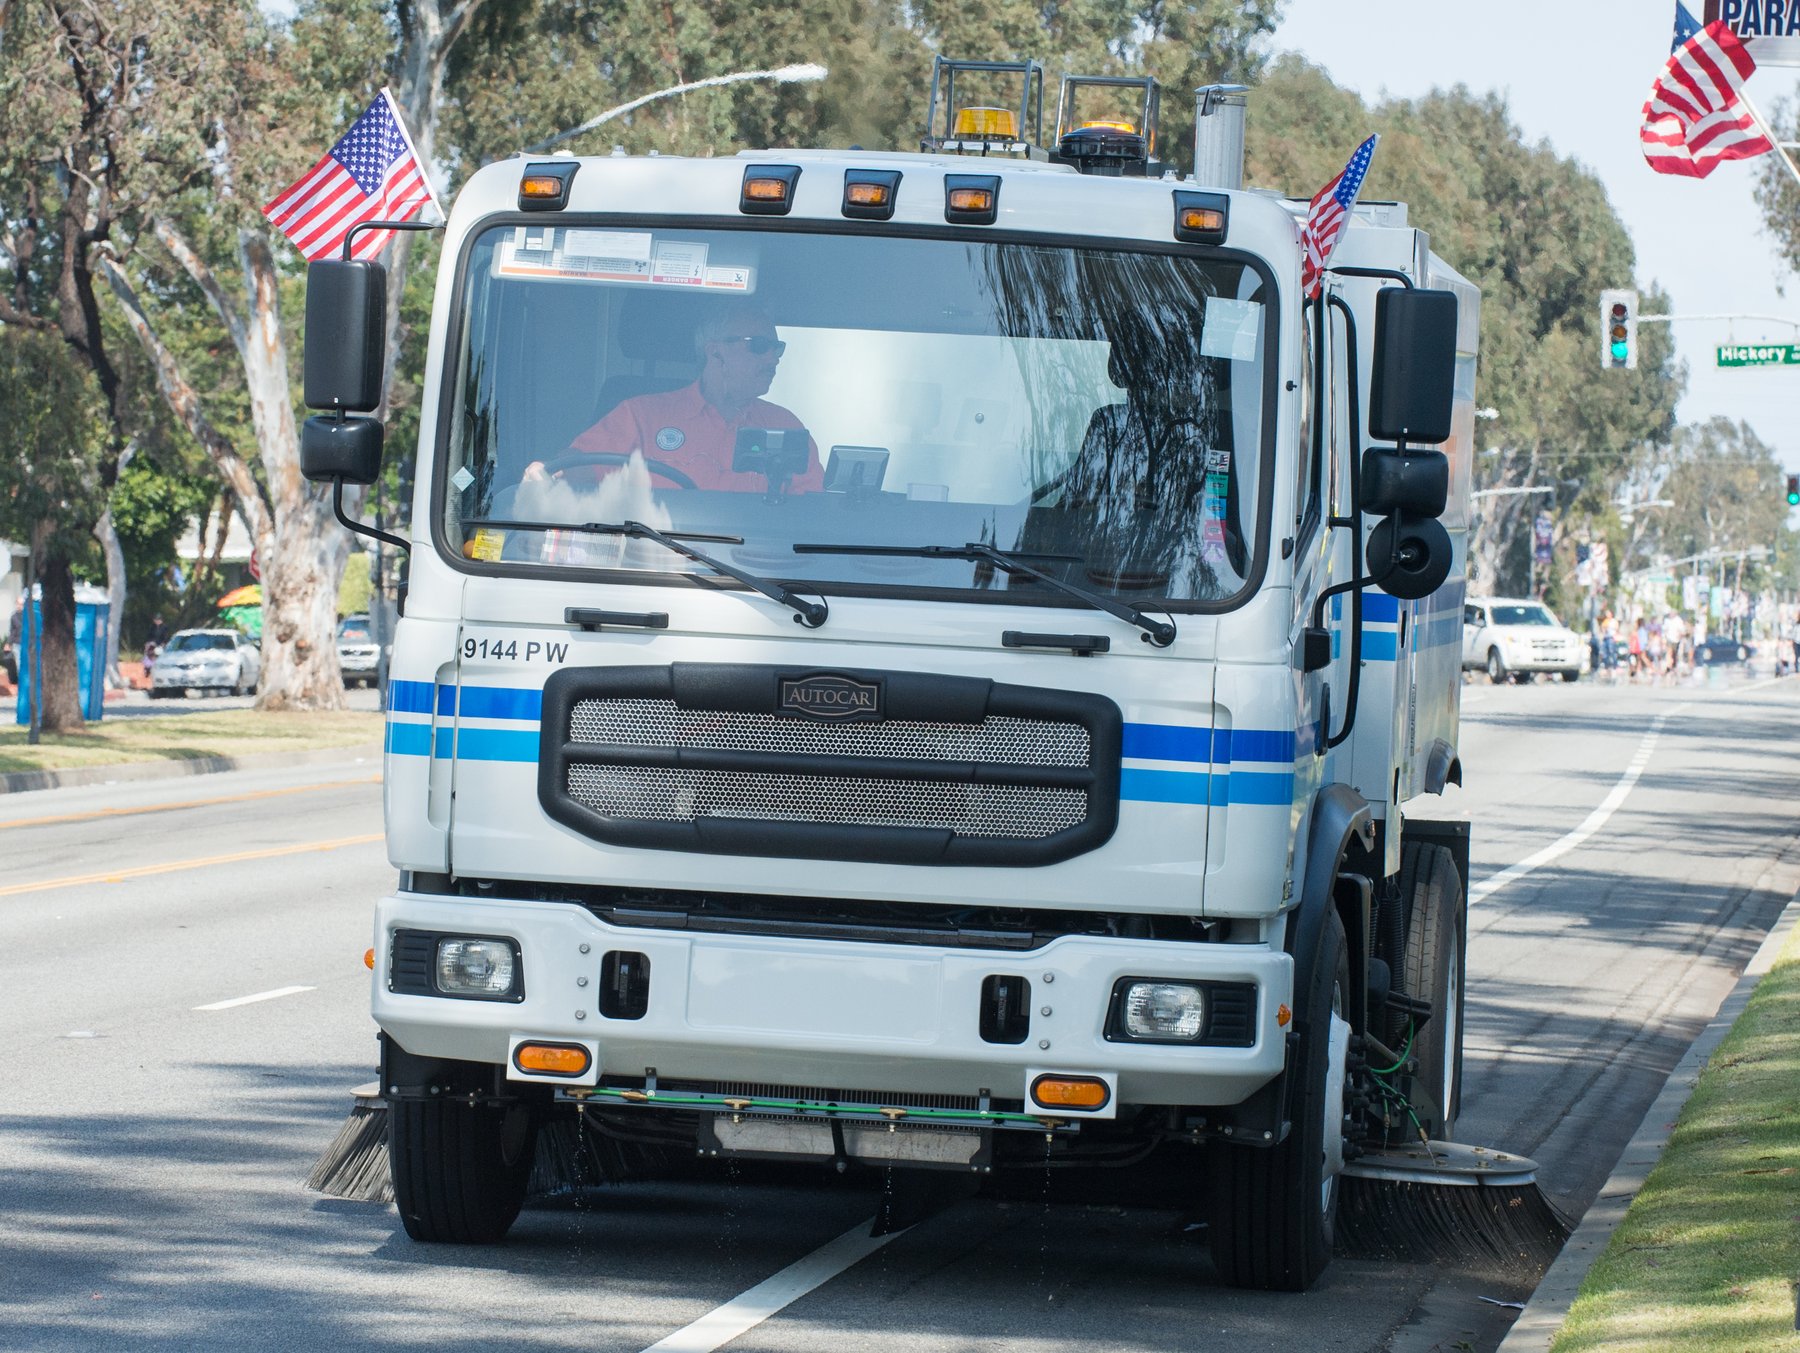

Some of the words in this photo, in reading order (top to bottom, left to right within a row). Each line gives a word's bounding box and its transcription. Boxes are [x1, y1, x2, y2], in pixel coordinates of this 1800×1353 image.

[1720, 346, 1786, 362] Hickory
[464, 638, 518, 660] 9144
[789, 687, 872, 706] AUTOCAR
